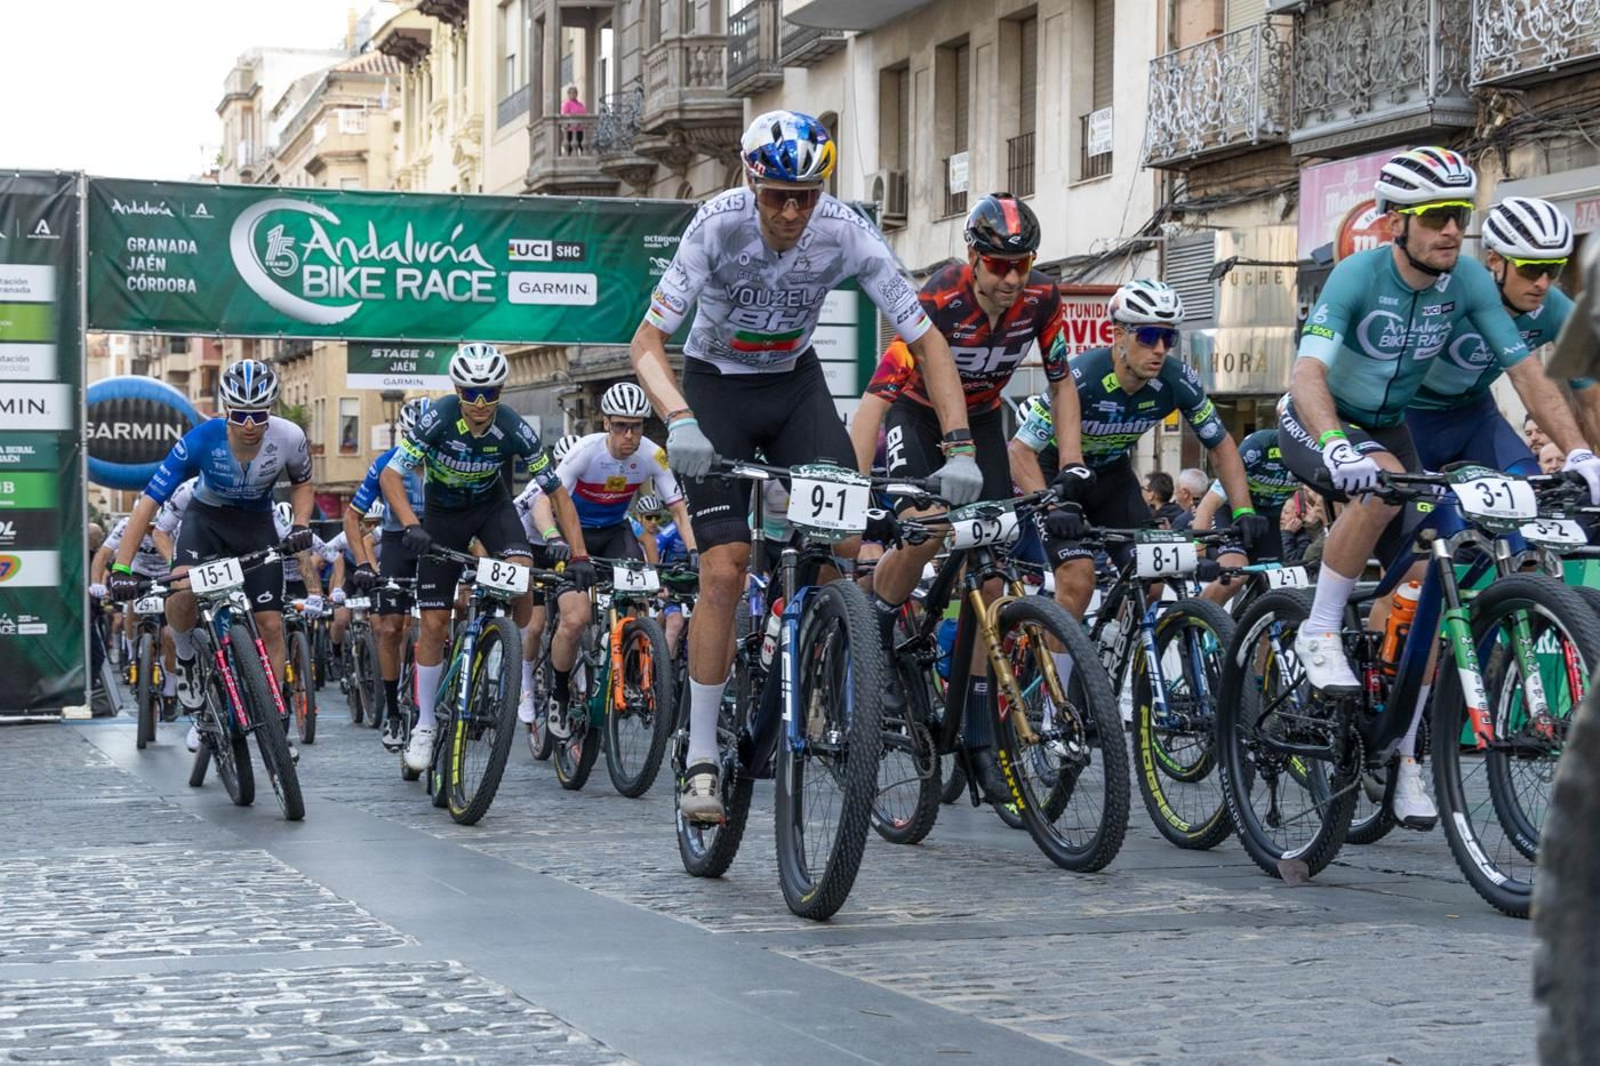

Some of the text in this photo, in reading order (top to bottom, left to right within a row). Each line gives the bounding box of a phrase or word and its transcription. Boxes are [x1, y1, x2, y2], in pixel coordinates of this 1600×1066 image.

[126, 236, 198, 255] GRANADA
[299, 217, 495, 271] Andalucía
[515, 242, 581, 258] UCI SHC
[126, 254, 167, 272] JAÉN
[126, 273, 198, 294] CÓRDOBA
[302, 264, 497, 303] BIKE RACE
[518, 281, 589, 296] GARMIN
[728, 306, 810, 332] BH
[1377, 334, 1416, 348] BIKE
[370, 348, 435, 360] STAGE 4
[950, 340, 1034, 373] BH
[1210, 350, 1269, 374] HORA
[389, 360, 417, 372] JAÉN
[383, 377, 424, 386] GARMIN
[86, 421, 183, 441] GARMIN
[811, 484, 847, 522] 9-1
[1475, 481, 1515, 509] 3-1
[972, 518, 1002, 546] 9-2
[1536, 521, 1570, 537] 3-2
[1153, 546, 1180, 572] 8-1
[198, 562, 233, 587] 15-1
[490, 562, 517, 586] 8-2
[625, 570, 647, 586] 4-1
[1280, 568, 1298, 585] 2-1
[139, 600, 159, 611] 29-1
[999, 749, 1026, 810] MAXXIS
